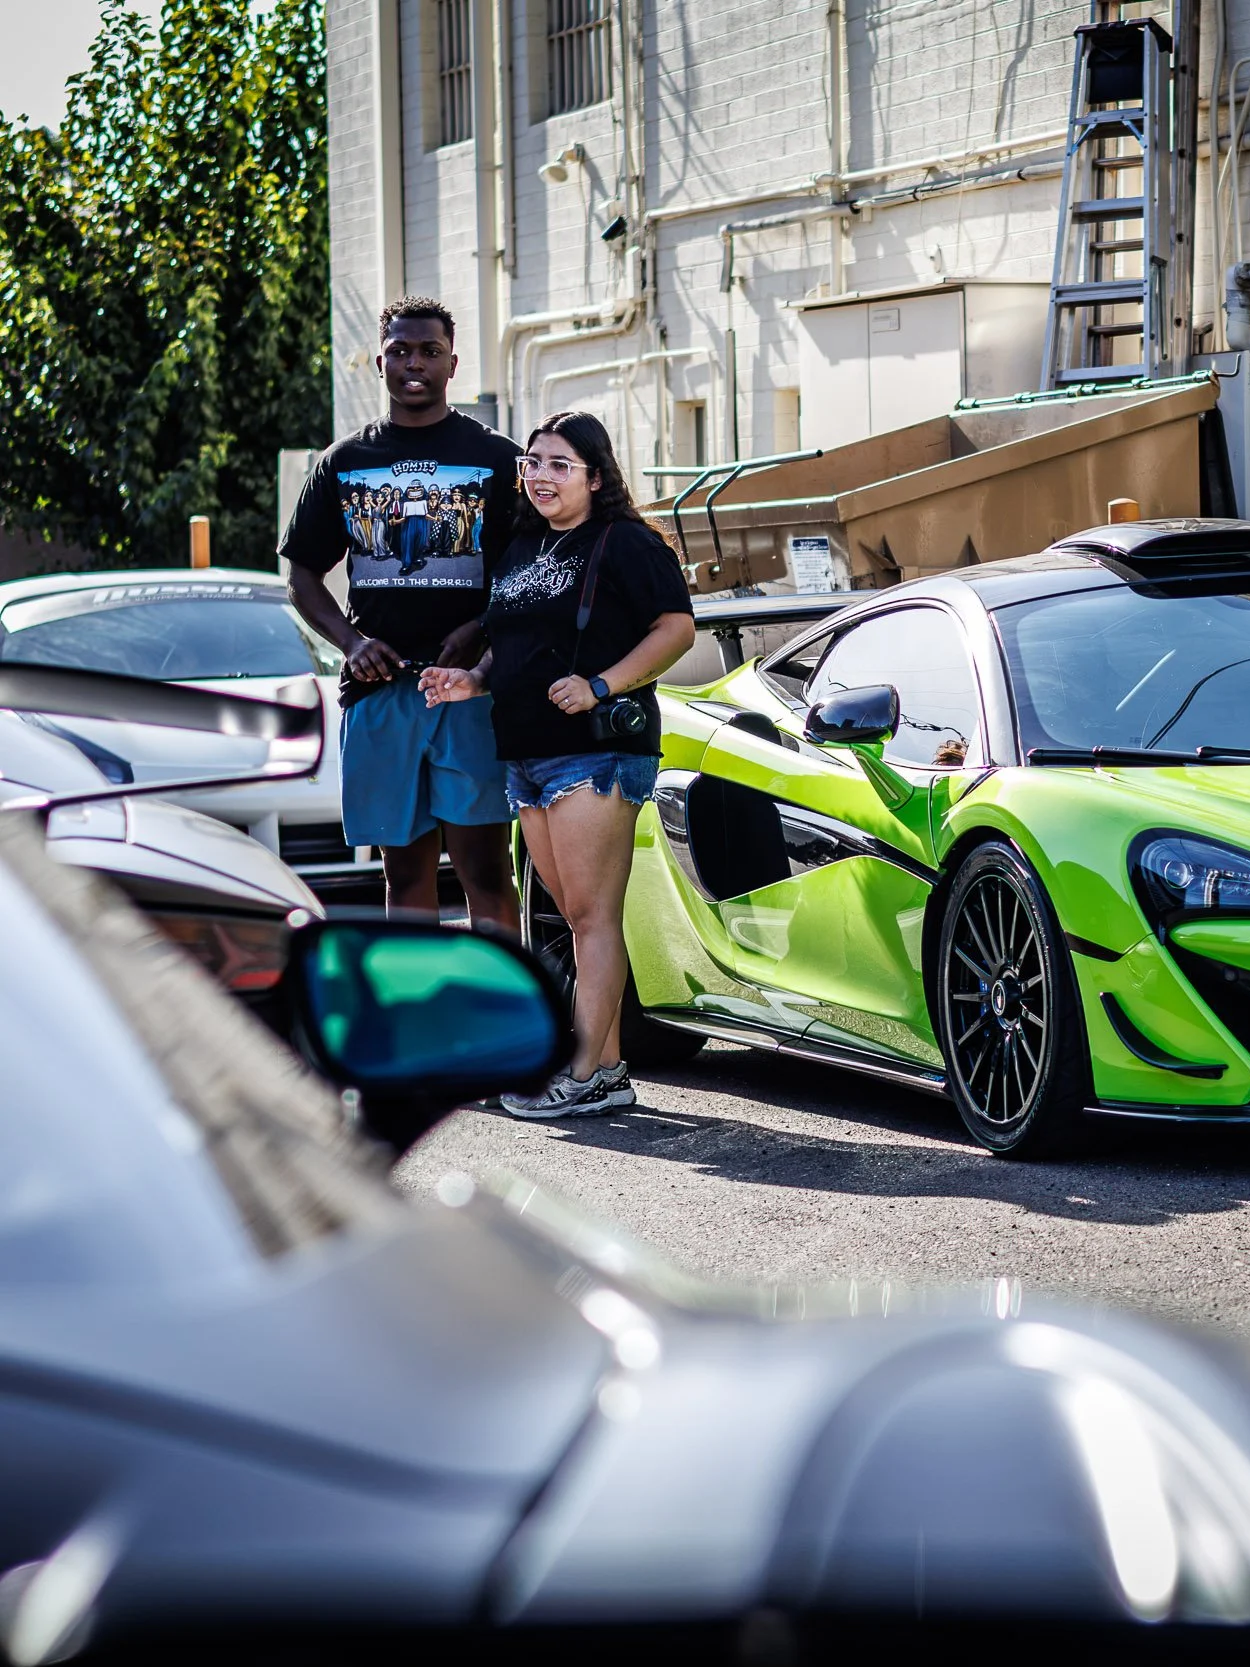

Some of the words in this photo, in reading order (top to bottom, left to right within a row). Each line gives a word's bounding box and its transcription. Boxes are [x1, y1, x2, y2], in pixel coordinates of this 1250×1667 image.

[392, 461, 436, 476] HOMIES
[391, 578, 405, 586] TO
[408, 578, 429, 586] THE
